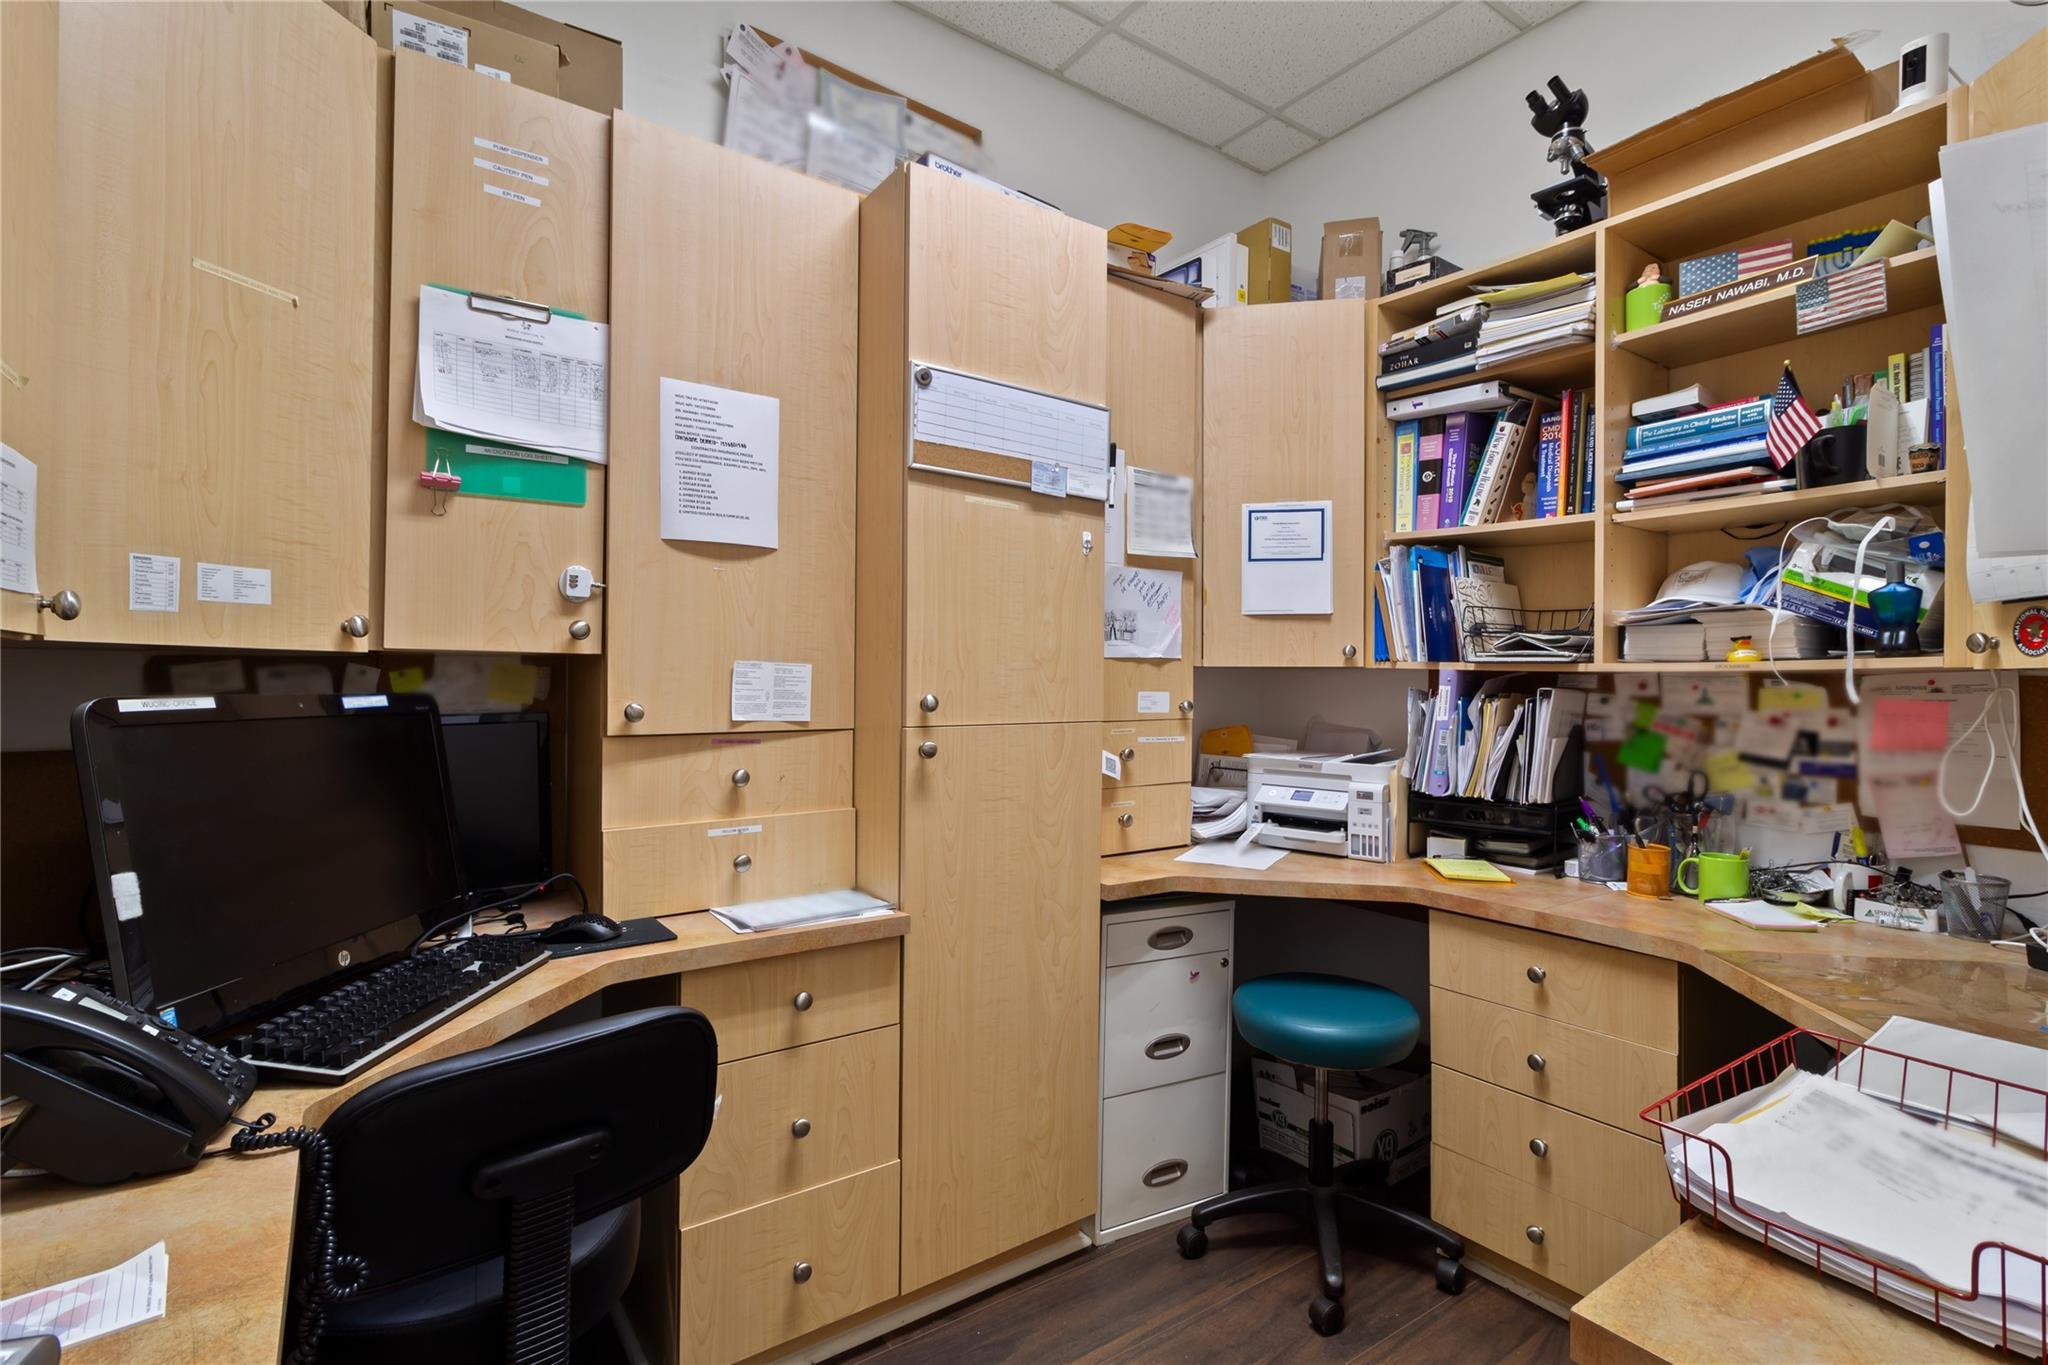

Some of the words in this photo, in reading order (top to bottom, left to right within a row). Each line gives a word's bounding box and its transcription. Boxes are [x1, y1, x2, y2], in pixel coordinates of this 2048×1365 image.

[492, 143, 510, 153] PUMP
[492, 164, 520, 177] CAUTERY
[520, 172, 534, 181] PEN
[934, 161, 962, 178] brother
[502, 190, 512, 199] EPI
[512, 193, 526, 201] PEN
[1668, 295, 1712, 316] NASEH
[1715, 278, 1770, 300] NAWABI,
[1776, 266, 1806, 283] M.D.
[1389, 357, 1420, 371] ZOHAR
[1542, 424, 1561, 433] CMD
[1643, 429, 1653, 438] The
[1653, 424, 1683, 437] Laboratory
[1689, 417, 1710, 429] Clinical
[1711, 413, 1737, 424] Medicine
[484, 447, 519, 458] MEDICATION
[2014, 608, 2038, 637] NATIONAL
[1273, 1110, 1286, 1125] X9
[1376, 1136, 1394, 1162] X9
